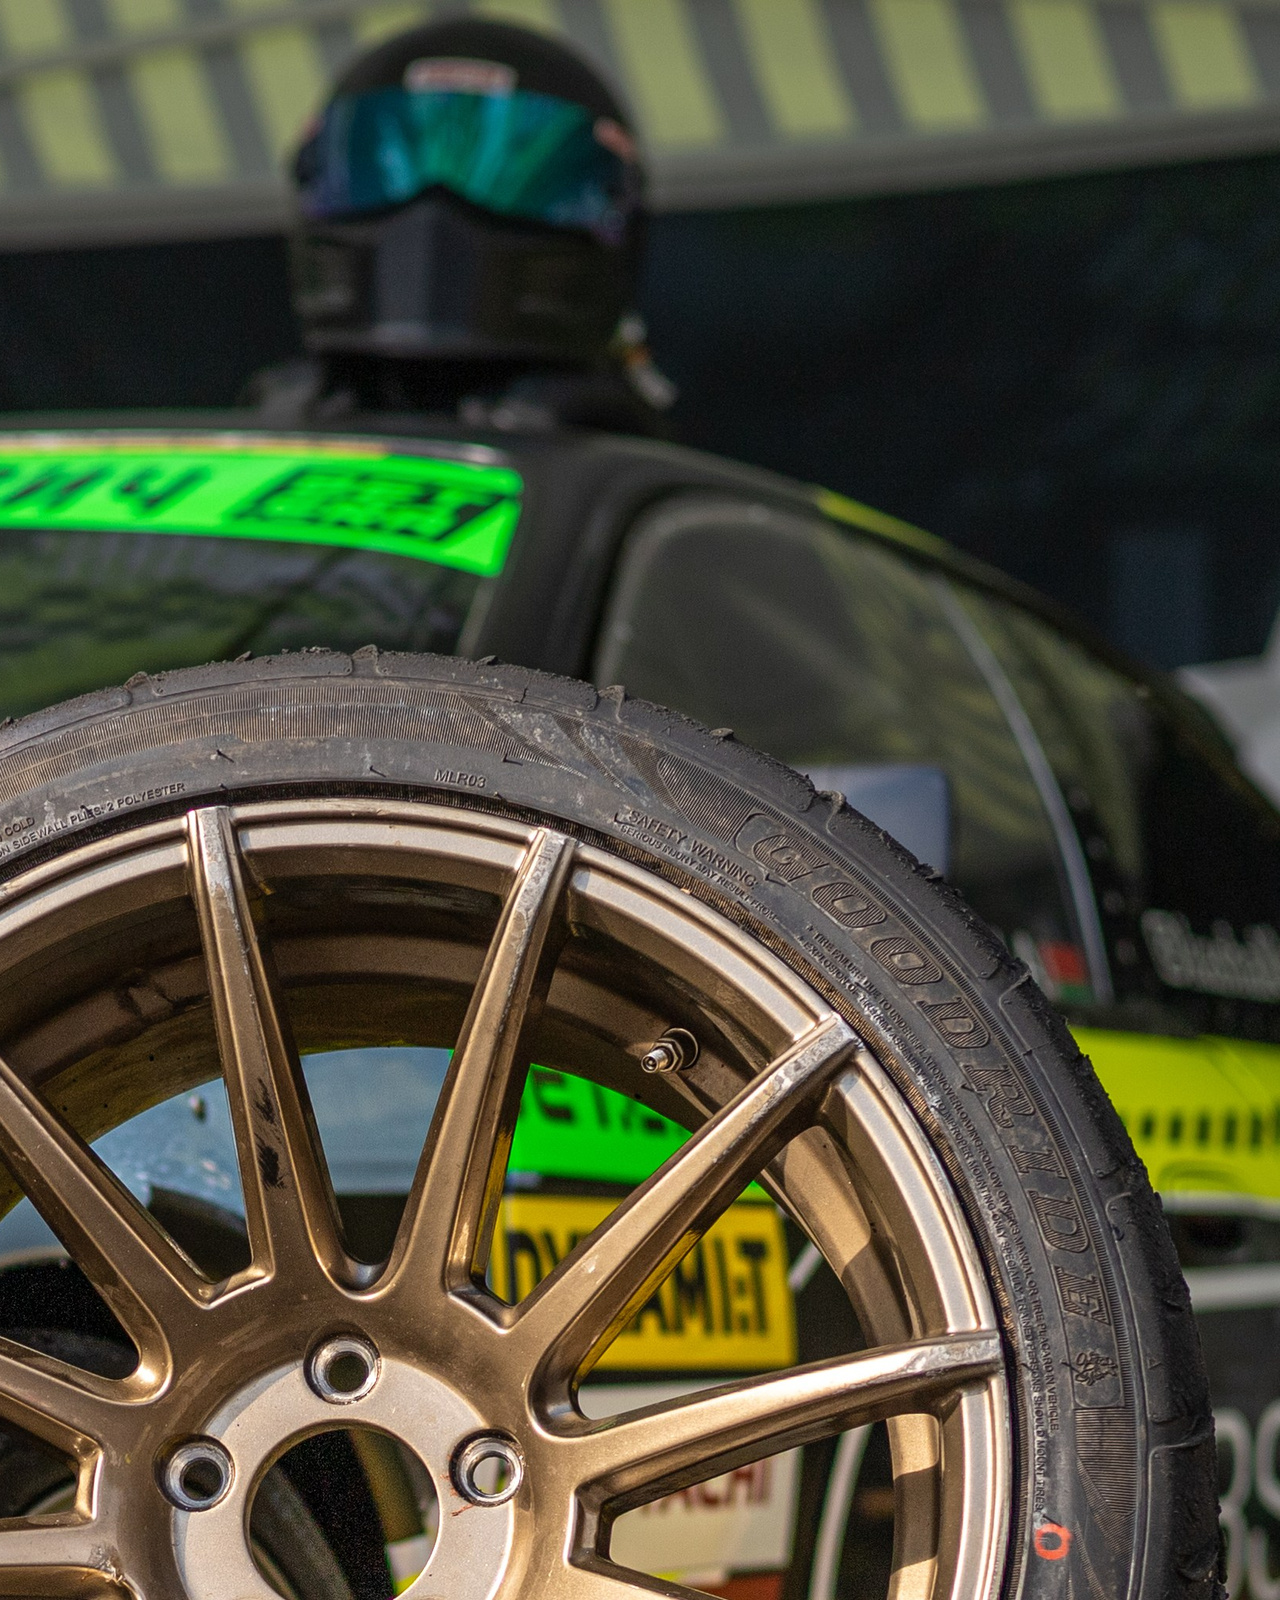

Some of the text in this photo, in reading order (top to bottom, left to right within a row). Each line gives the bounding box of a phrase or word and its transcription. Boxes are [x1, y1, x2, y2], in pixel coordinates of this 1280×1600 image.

[433, 764, 489, 792] MLR03
[1, 814, 38, 838] COLD
[10, 818, 68, 850] SIDEWALL
[68, 803, 105, 826] PLIES:
[105, 800, 115, 813] 2
[115, 780, 186, 809] POLYESTER
[619, 822, 663, 850] SERIOUS
[660, 842, 699, 869] INJURY
[694, 860, 719, 881] MAY
[715, 873, 753, 903] RESULT
[626, 806, 762, 892] SAFETY WARNING:
[801, 938, 851, 987] EXPLOSION
[812, 929, 837, 954] TIRE
[830, 946, 867, 983] FAILURE
[844, 980, 862, 998] OF
[876, 995, 894, 1012] TO
[746, 818, 1114, 1334] GOODRIDE
[920, 1075, 940, 1098] DUE
[932, 1096, 949, 1113] TO
[939, 1109, 976, 1161] IMPROPER
[994, 1187, 1023, 1236] OWNER'S
[998, 1239, 1026, 1295] SPECIALLY
[1011, 1234, 1037, 1280] MANUAL
[1024, 1277, 1041, 1297] OR
[1029, 1296, 1046, 1322] TIRE
[1014, 1294, 1037, 1342] TRAINED
[1024, 1342, 1045, 1393] PERSONS
[1034, 1321, 1056, 1373] PLACARD
[1043, 1372, 1056, 1386] IN
[1031, 1393, 1048, 1439] SHOULD
[1033, 1438, 1049, 1477] MOUNT
